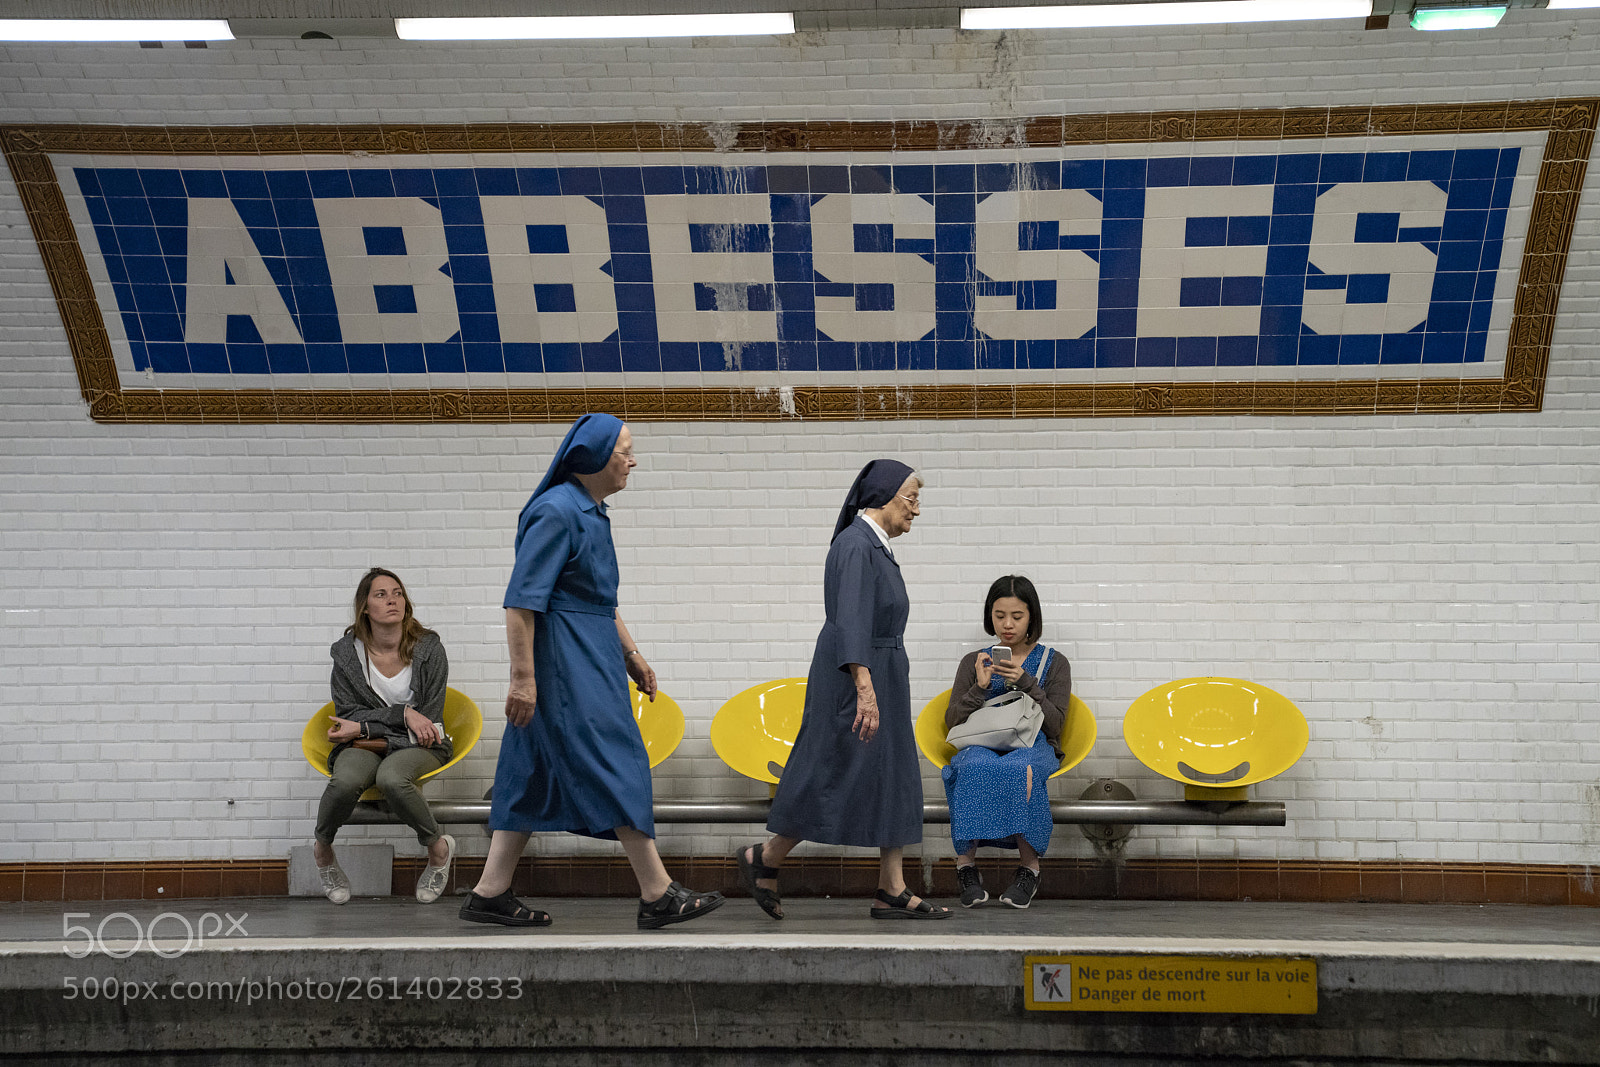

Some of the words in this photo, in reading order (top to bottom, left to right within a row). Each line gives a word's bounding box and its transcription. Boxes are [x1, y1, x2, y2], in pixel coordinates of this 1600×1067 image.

[184, 180, 1448, 345] ABBESSES
[1078, 966, 1100, 981] Ne
[1106, 968, 1133, 983] pas
[1138, 966, 1221, 982] descendre
[1226, 970, 1251, 982] sur
[1256, 968, 1271, 982] la
[1276, 971, 1310, 983] voie
[1079, 986, 1136, 1004] Danger
[1142, 987, 1162, 1001] de
[1167, 989, 1206, 1002] mort
